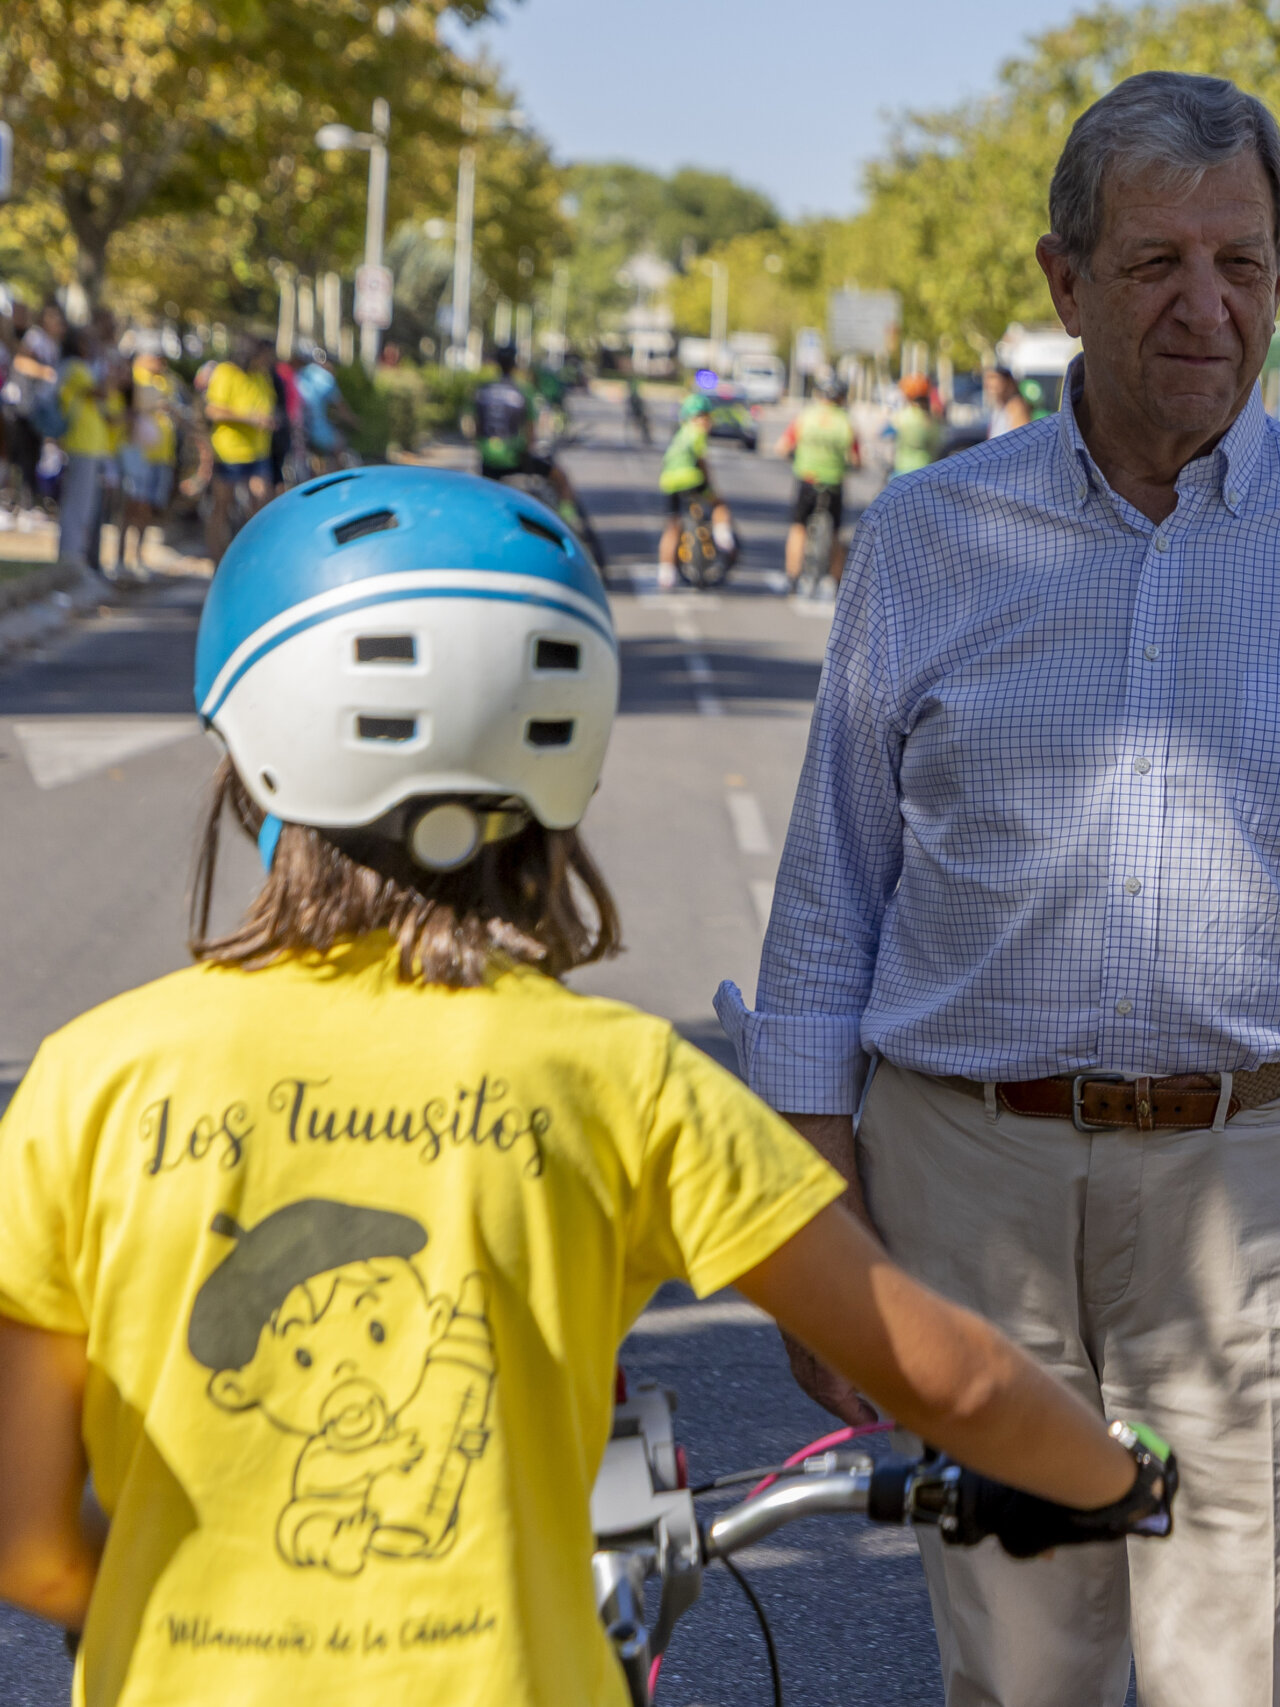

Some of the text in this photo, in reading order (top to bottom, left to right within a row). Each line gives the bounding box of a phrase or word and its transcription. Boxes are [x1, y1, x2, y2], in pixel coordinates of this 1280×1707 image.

[139, 1073, 551, 1178] Los Tuuusitos
[325, 1620, 352, 1653] de
[361, 1617, 388, 1655] la
